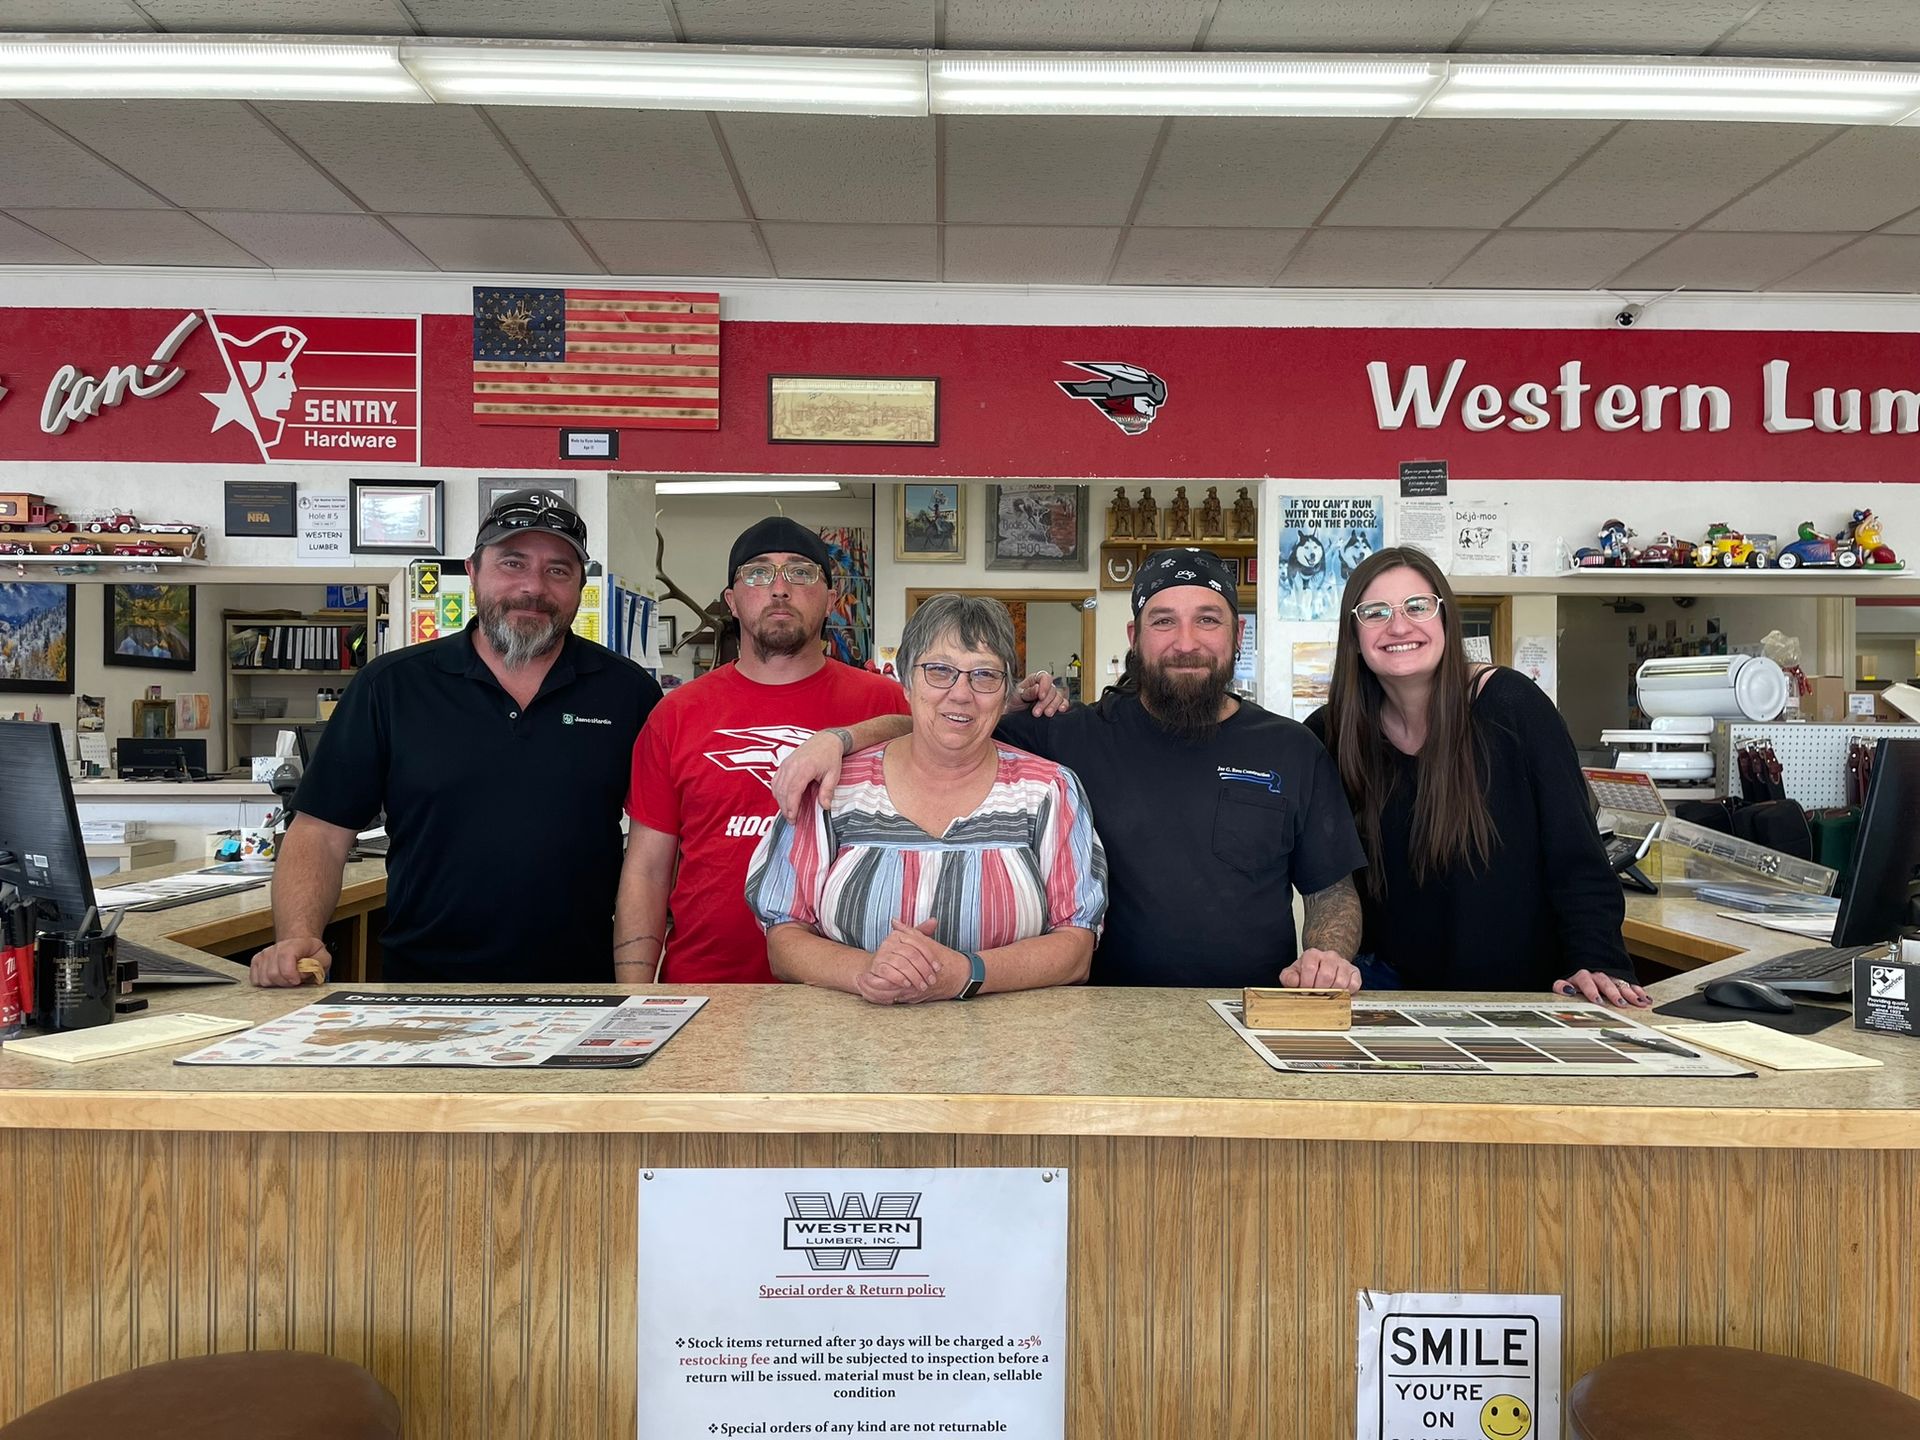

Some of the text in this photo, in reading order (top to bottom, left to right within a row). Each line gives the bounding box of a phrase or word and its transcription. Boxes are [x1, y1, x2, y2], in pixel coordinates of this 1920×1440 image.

[1366, 358, 1731, 432] Western
[305, 399, 397, 424] SENTRY
[304, 430, 397, 448] Hardware
[1290, 500, 1372, 509] IF YOU CAN'T RUN
[247, 512, 270, 523] NRA
[308, 512, 326, 520] Hole
[1285, 509, 1377, 521] WITH THE BIG DOGS,
[1284, 519, 1378, 529] STAY ON THE PORCH.
[345, 994, 605, 1004] Deck Connector System
[1867, 997, 1891, 1006] Providing
[795, 1223, 911, 1233] WESTERN
[873, 1237, 900, 1245] INC.
[759, 1283, 946, 1298] Special order & Return policy
[687, 1335, 1042, 1352] Stock items returned after 30 days will be charged a 25%
[1390, 1326, 1529, 1366] SMILE
[679, 1352, 1049, 1368] restocking fee and will be subjected to inspection before a
[686, 1368, 1042, 1384] return will be issued. material must be in clean, sellable
[834, 1386, 896, 1399] condition
[1396, 1383, 1483, 1401] YOU'RE
[1422, 1411, 1454, 1428] ON
[721, 1420, 1007, 1438] Special orders of any kind are not returnable
